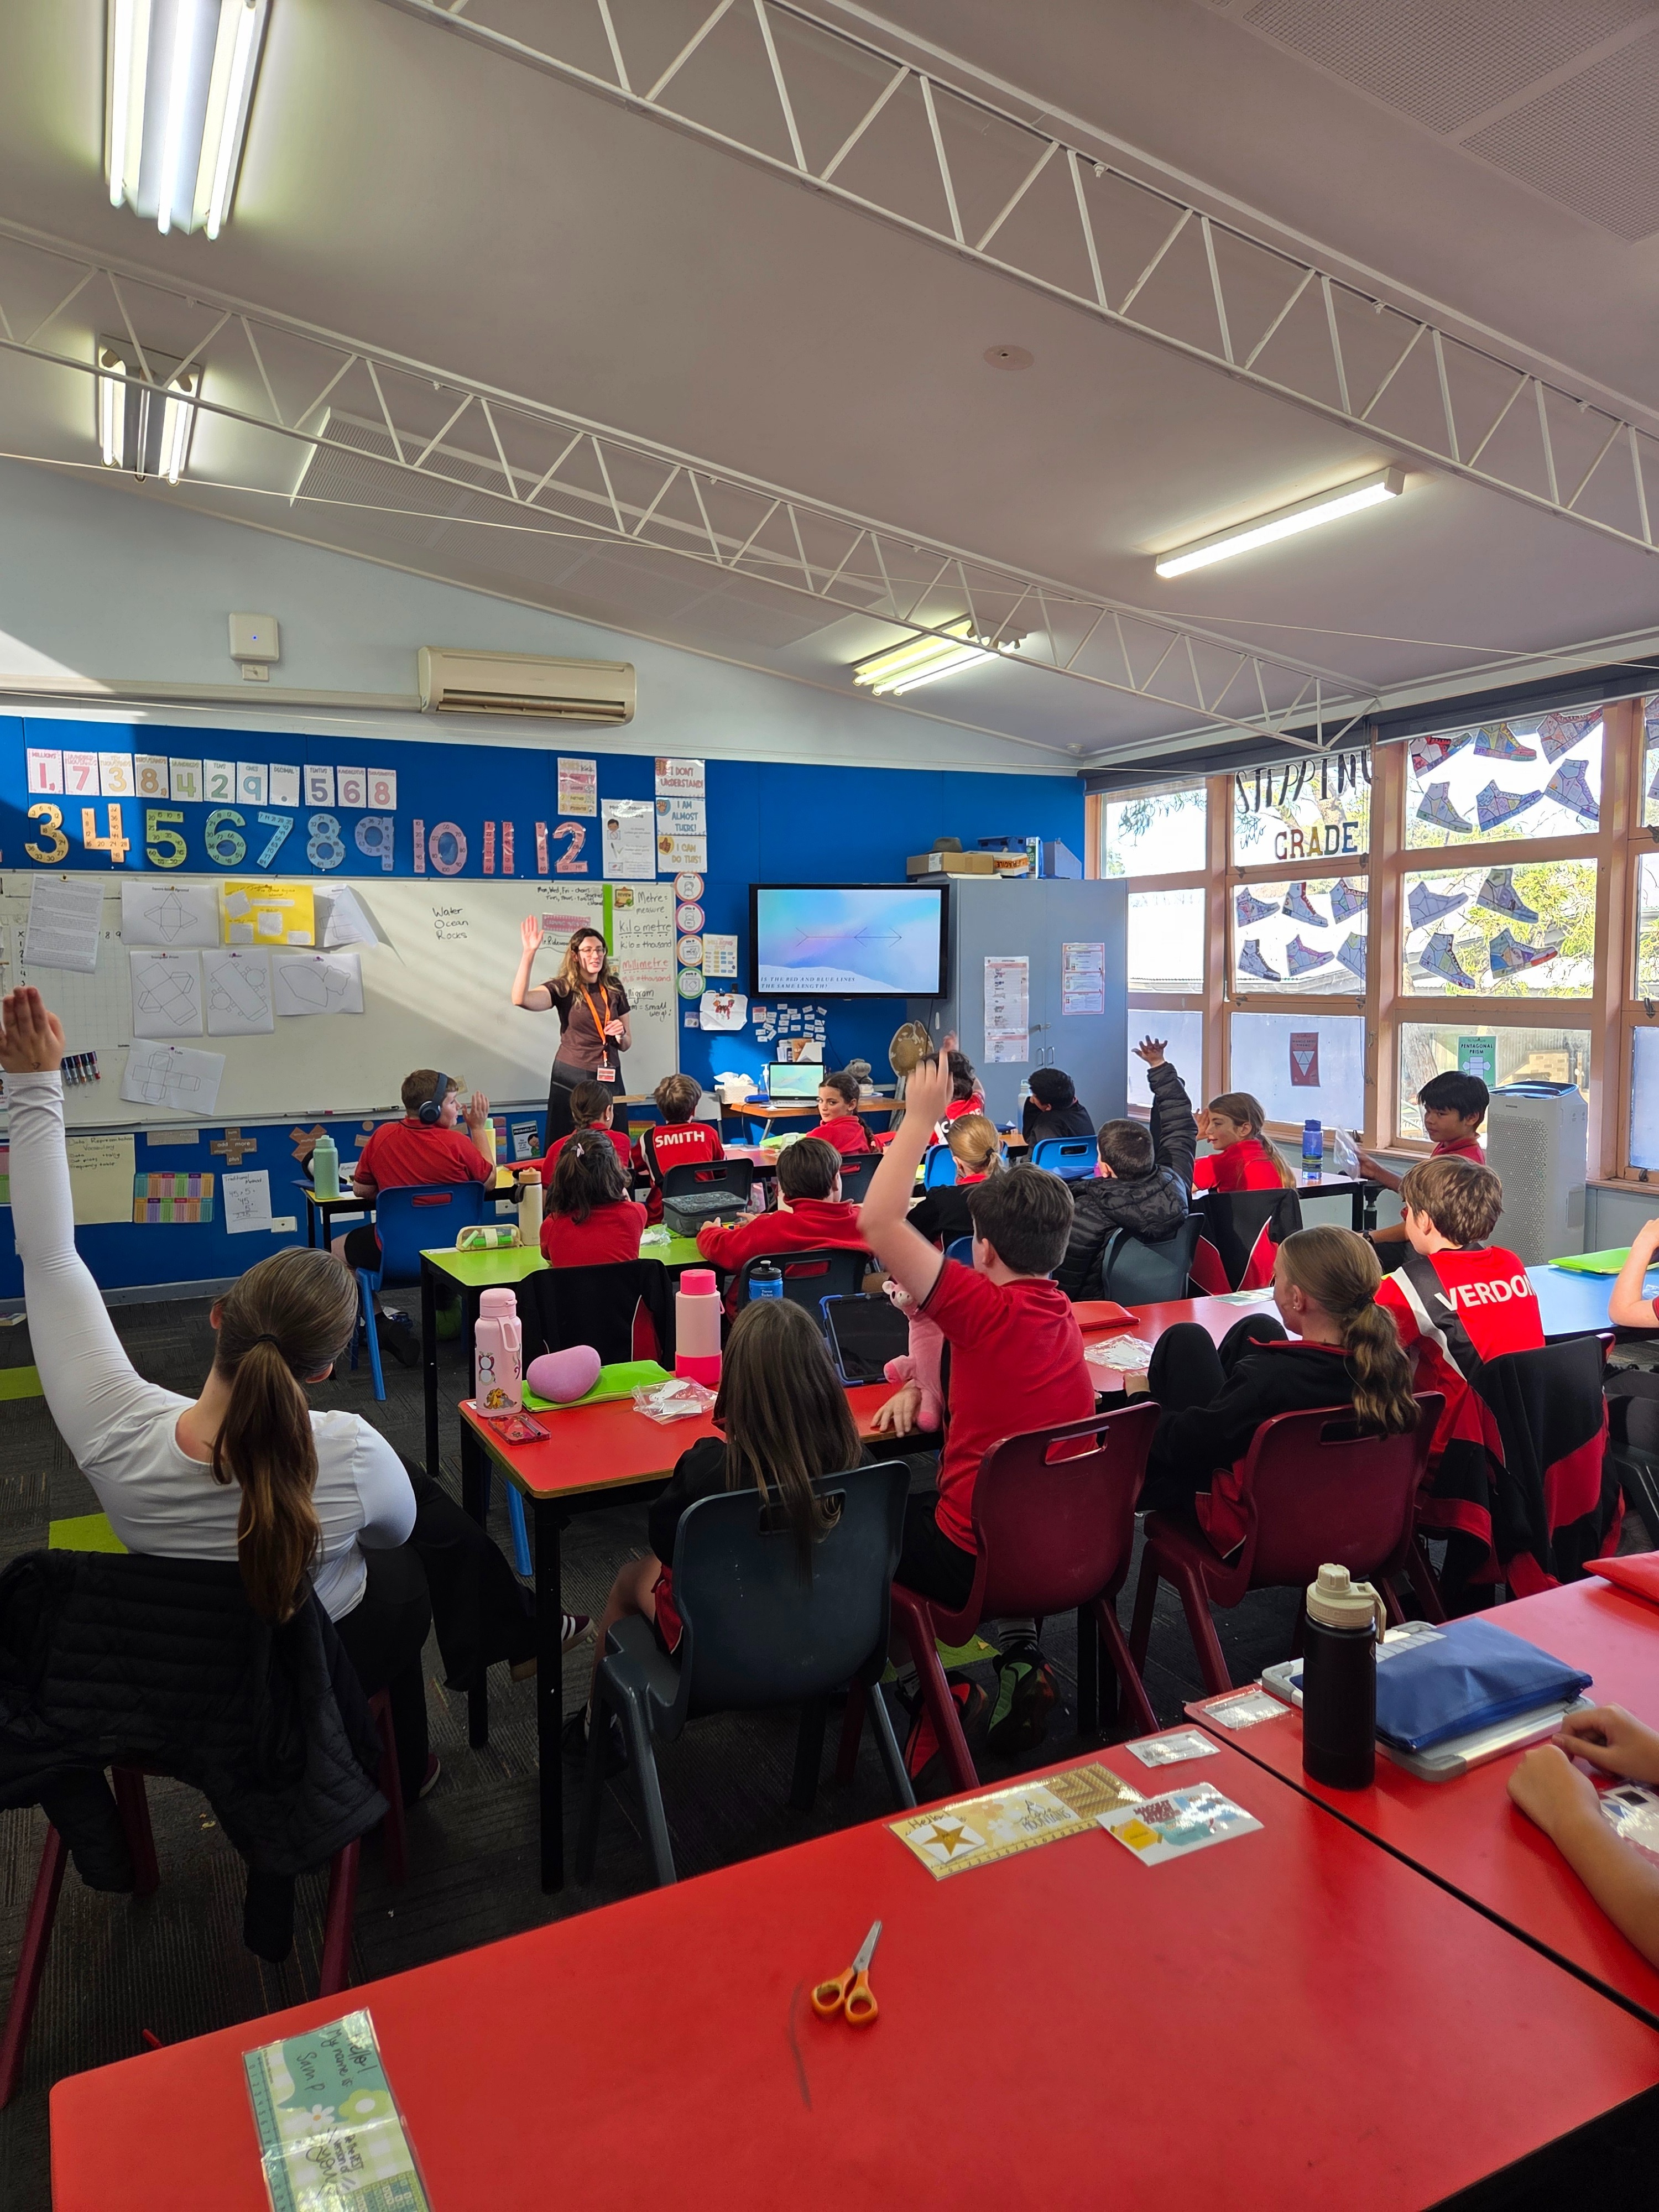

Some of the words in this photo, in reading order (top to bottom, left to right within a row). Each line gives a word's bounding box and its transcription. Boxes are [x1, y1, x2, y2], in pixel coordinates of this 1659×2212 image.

[73, 766, 90, 791] 7
[109, 767, 127, 791] 3
[176, 773, 196, 798] 4
[211, 774, 228, 799] 2
[243, 776, 261, 801] 9
[311, 778, 328, 802] 5
[660, 779, 703, 789] UNDERSTAND!
[343, 780, 360, 804] 6
[374, 781, 390, 805] 8
[671, 812, 698, 821] ALMOST
[675, 823, 696, 832] THERE!
[24, 803, 69, 863] 3
[82, 804, 129, 863] 4
[146, 809, 187, 868] 5
[205, 809, 246, 866] 6
[256, 811, 293, 869] 7
[306, 813, 346, 869] 8
[354, 816, 394, 871] 9
[1274, 821, 1359, 860] GRADE
[413, 819, 467, 875] 10
[483, 821, 514, 874] 11
[535, 822, 589, 874] 12
[681, 844, 696, 852] CAN
[638, 891, 663, 904] Metre
[432, 906, 463, 917] Water
[434, 920, 468, 929] Ocean
[436, 930, 468, 940] Rocks
[642, 939, 672, 948] thousand
[645, 1002, 667, 1011] small
[655, 1130, 705, 1148] SMITH
[320, 2028, 342, 2047] My
[332, 2048, 349, 2077] name
[296, 2052, 317, 2081] Sam
[304, 2083, 325, 2092] P
[348, 2152, 364, 2169] BEST
